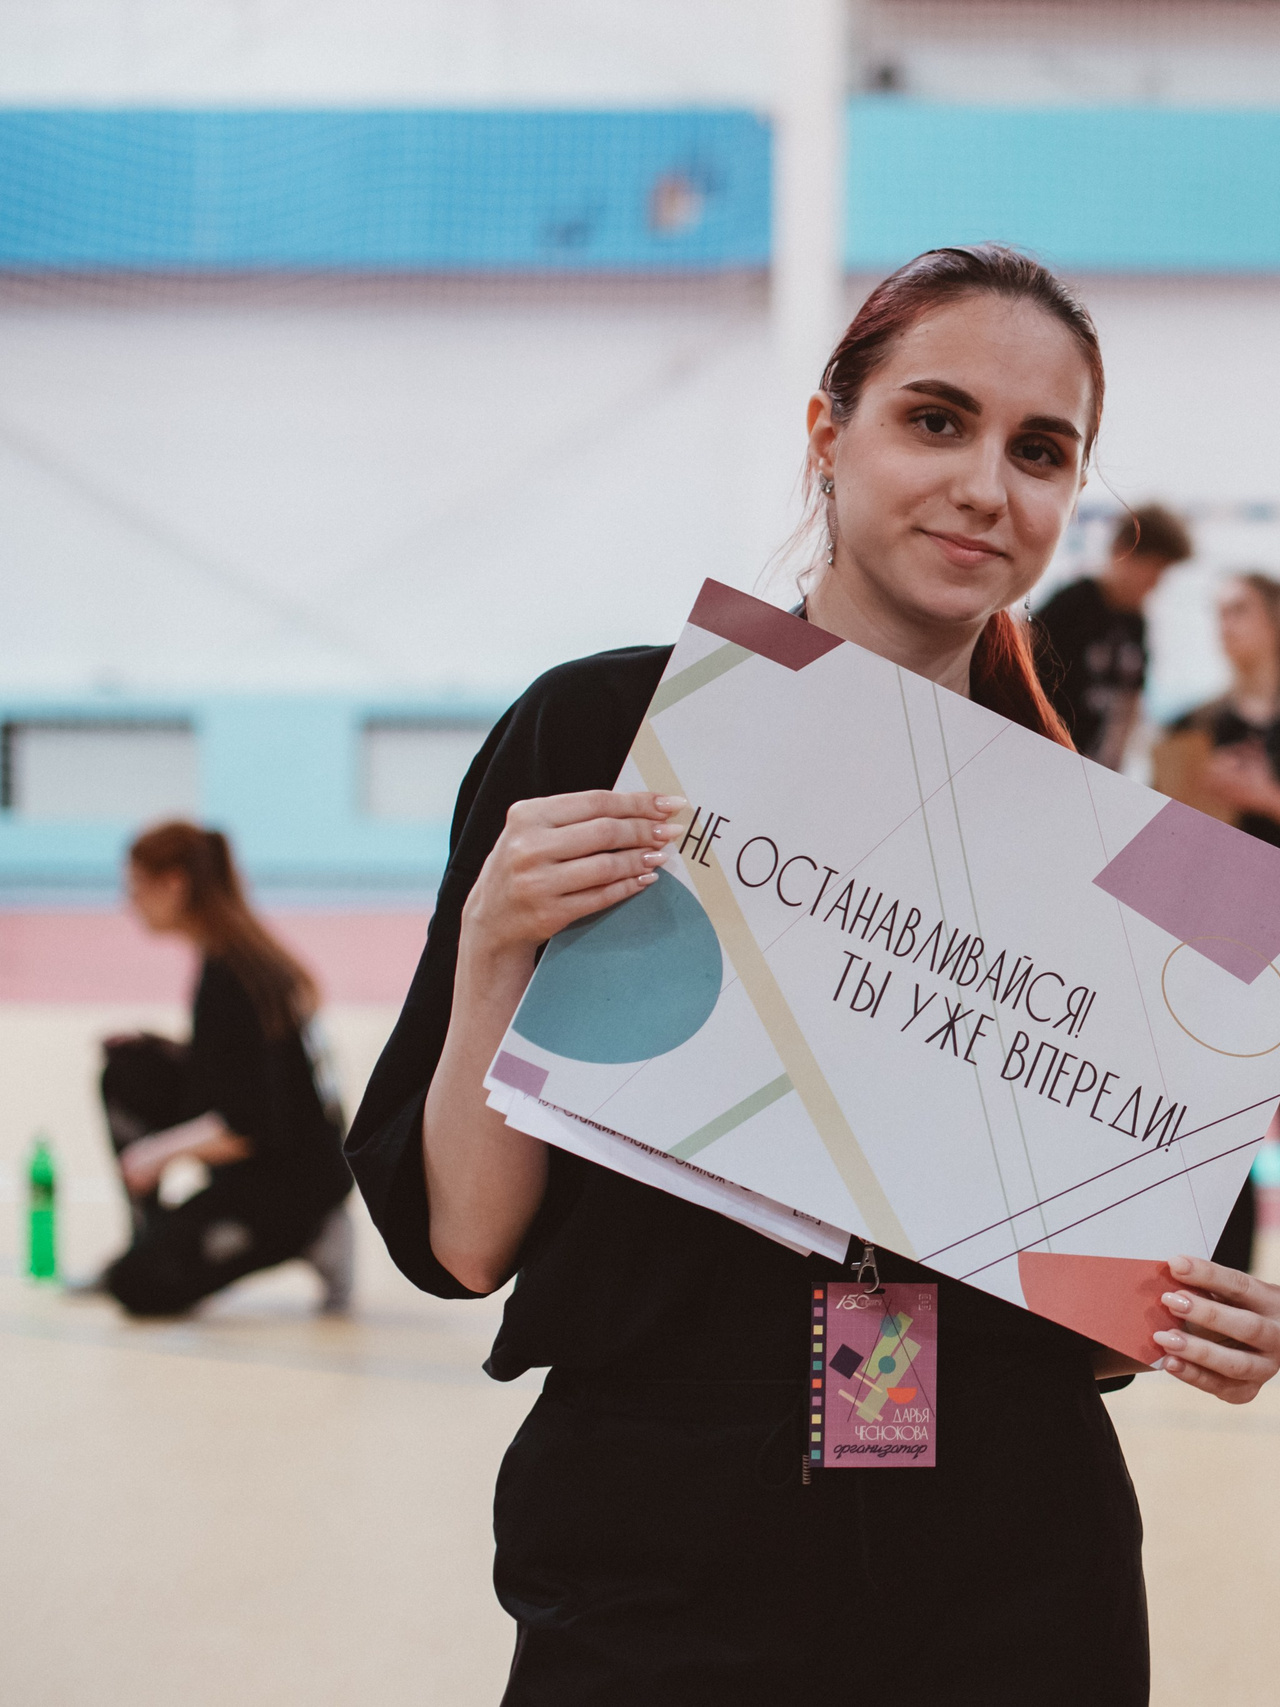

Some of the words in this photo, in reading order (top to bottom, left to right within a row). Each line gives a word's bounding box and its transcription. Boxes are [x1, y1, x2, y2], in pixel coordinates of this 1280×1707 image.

[679, 807, 730, 868] НЕ
[736, 836, 1097, 1039] ОСТАНАВЛИВАЙСЯ!
[832, 950, 892, 1019] ТЫ
[900, 983, 995, 1066] УЖЕ
[1000, 1030, 1188, 1154] ВПЕРЕДИ!
[893, 1408, 930, 1424] ДАРЬЯ
[855, 1425, 929, 1441] ЧЕСНОКОВА
[833, 1443, 928, 1460] организатор
